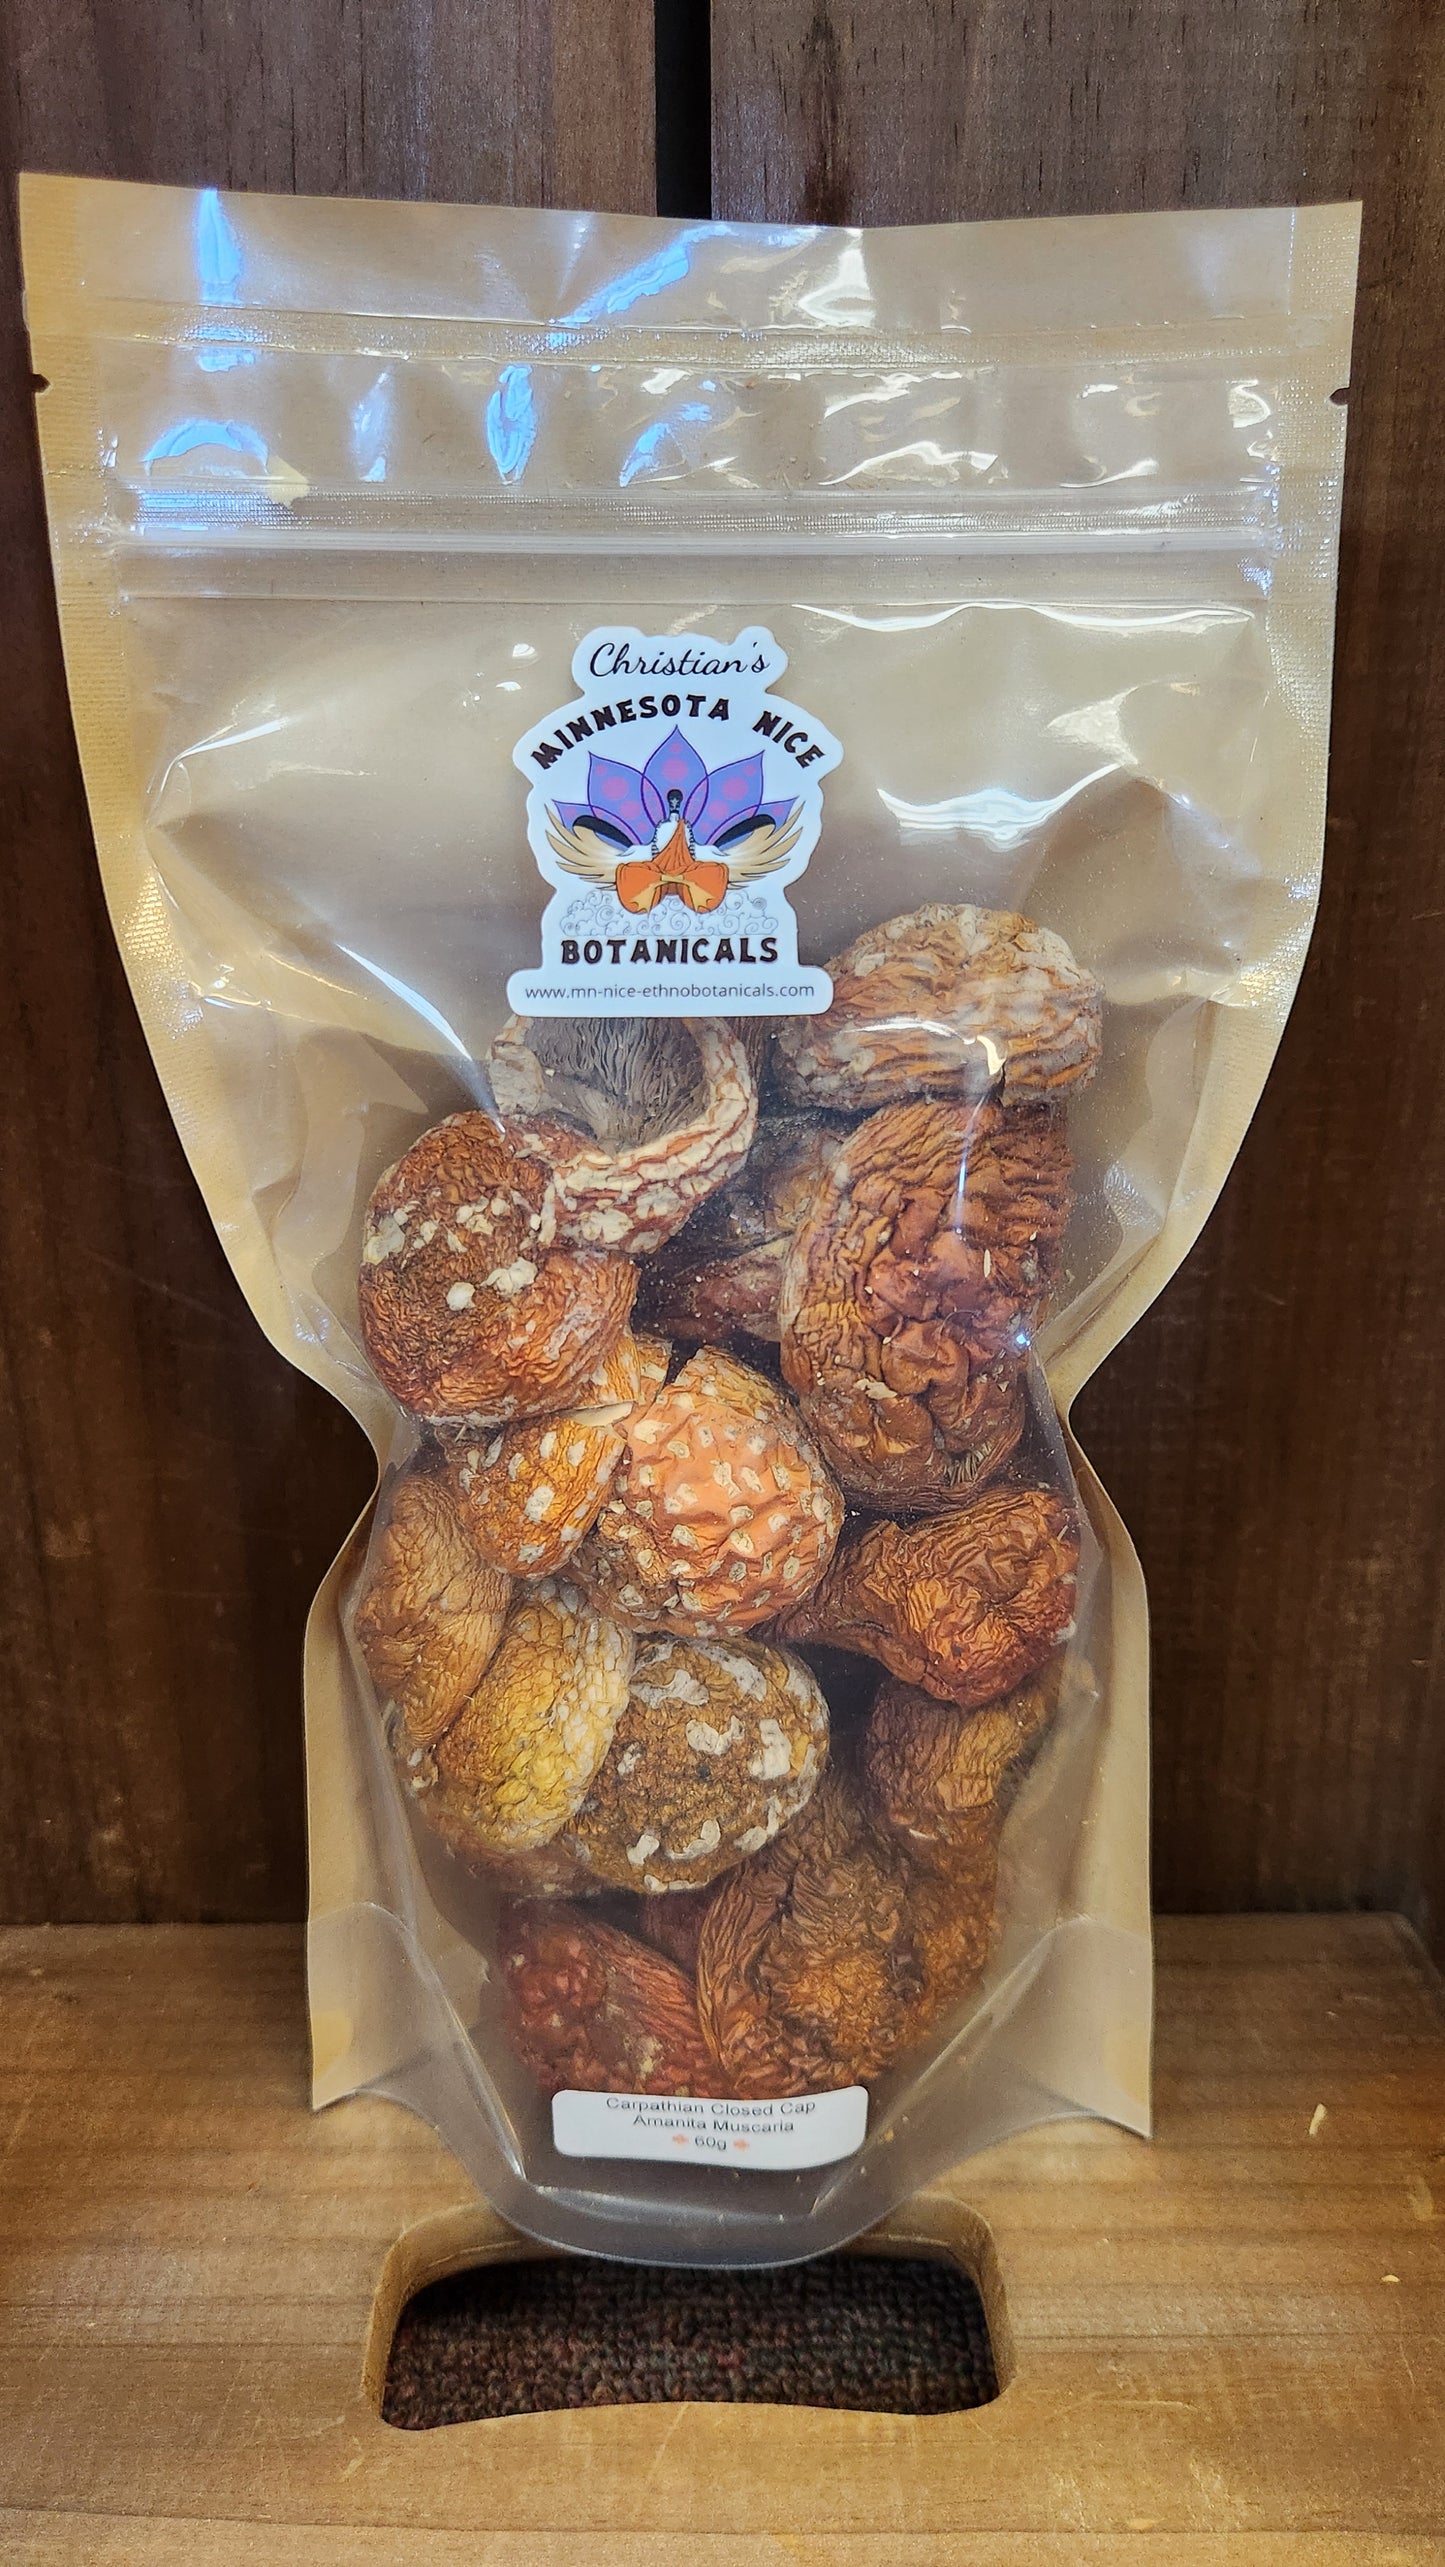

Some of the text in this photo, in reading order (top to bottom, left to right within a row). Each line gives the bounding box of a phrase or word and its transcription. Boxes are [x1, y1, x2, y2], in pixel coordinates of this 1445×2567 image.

[589, 641, 770, 677] Christian's
[530, 693, 826, 770] MINNESOTA NICE
[561, 936, 779, 965] BOTANICALS
[525, 983, 815, 1000] www.mn-nice-ethnobotanicals.com
[606, 2097, 815, 2116] Carpathian Closed Cap
[632, 2114, 795, 2133] Amanita Muscaria
[694, 2135, 727, 2151] 60g
